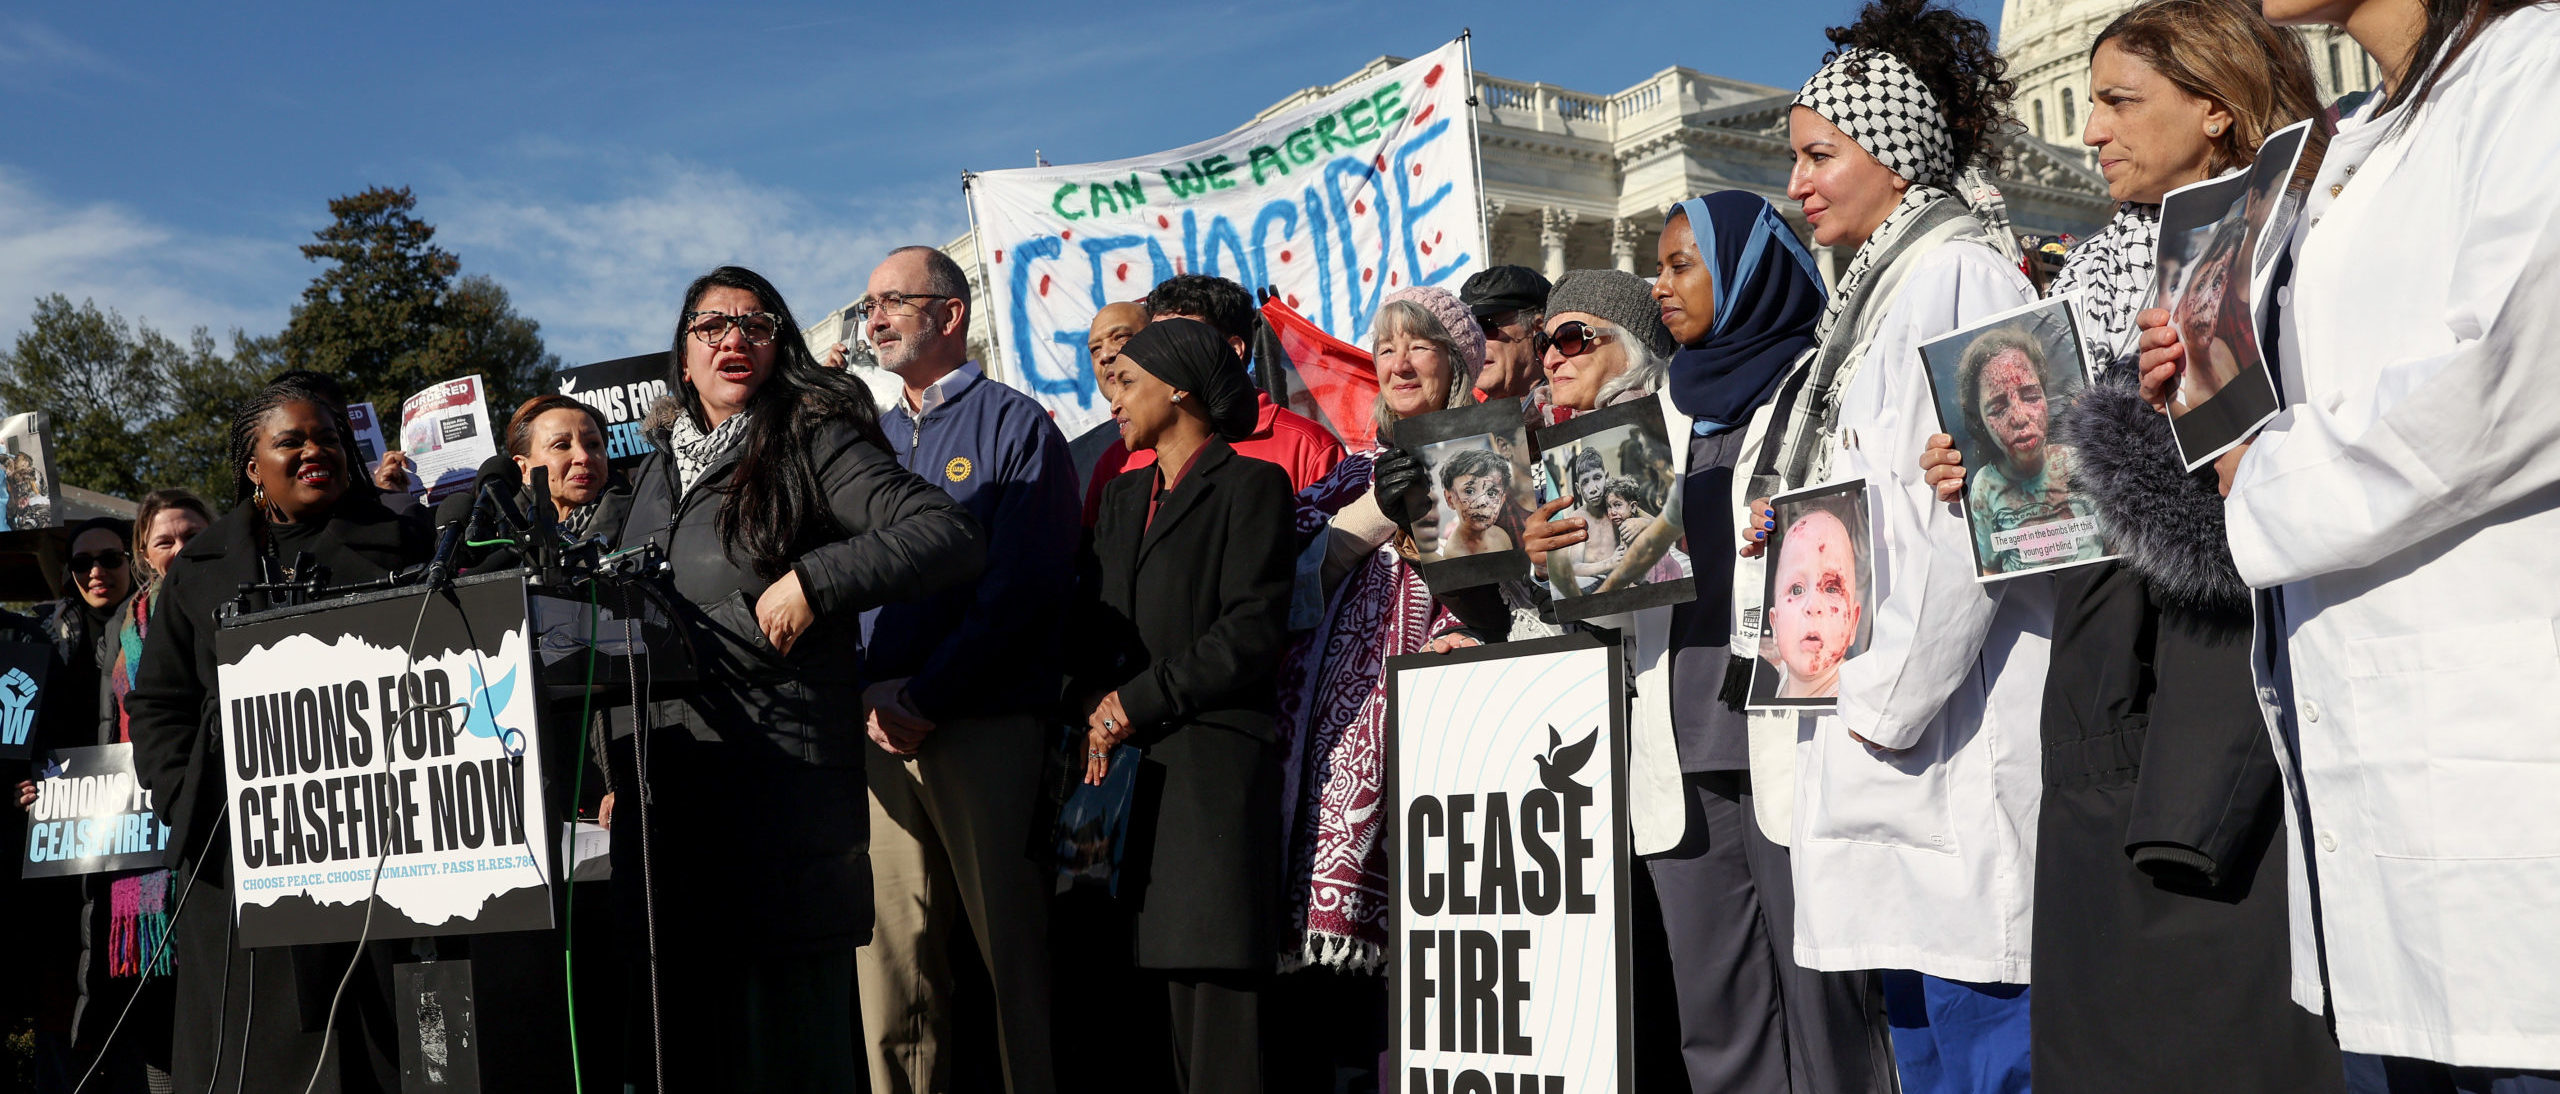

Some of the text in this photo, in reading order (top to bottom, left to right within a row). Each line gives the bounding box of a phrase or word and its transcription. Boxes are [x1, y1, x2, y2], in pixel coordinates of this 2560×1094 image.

[1052, 81, 1410, 221] CAN WE AGREE
[403, 383, 469, 413] MURDERED
[1995, 520, 2093, 546] The agent in the bombs left this
[2023, 540, 2072, 558] young girl blind
[231, 668, 455, 781] UNIONS FOR
[34, 772, 131, 821] UNIONS
[239, 768, 423, 869] CEASEFIRE
[427, 755, 525, 852] NOW
[29, 812, 153, 863] CEASEFIRE
[1408, 786, 1596, 917] CEASE
[243, 876, 285, 891] CHOOSE
[287, 873, 324, 887] PEACE.
[327, 869, 372, 884] CHOOSE
[442, 859, 475, 874] PASS
[1409, 929, 1533, 1056] FIRE
